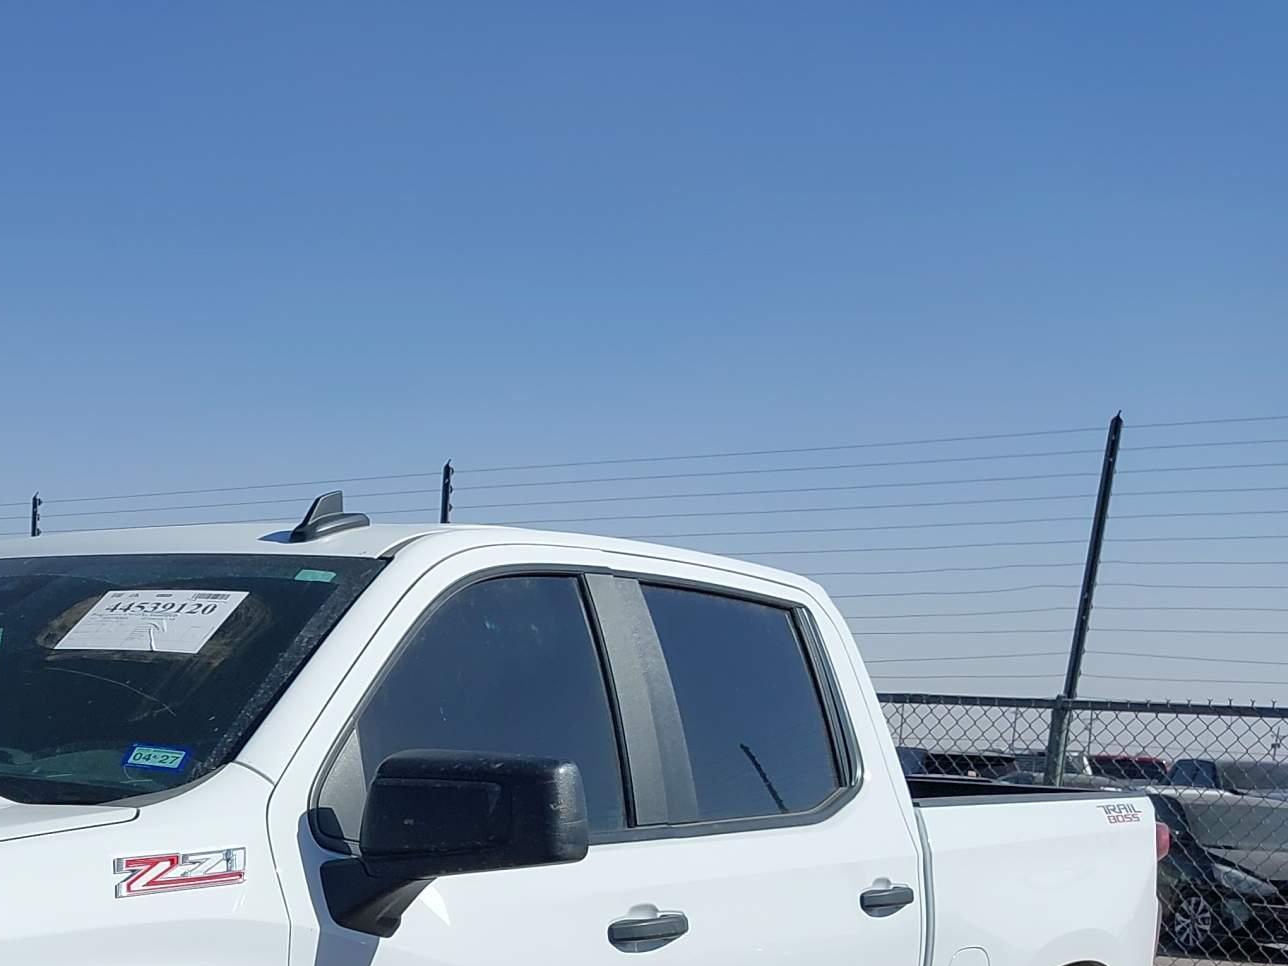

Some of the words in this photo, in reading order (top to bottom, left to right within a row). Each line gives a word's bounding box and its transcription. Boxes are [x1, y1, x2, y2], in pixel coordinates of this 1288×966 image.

[104, 601, 218, 615] 44539120
[159, 754, 180, 765] 27
[1096, 803, 1143, 815] TRAIL
[1107, 813, 1141, 824] BOSS
[112, 847, 246, 899] Z71
